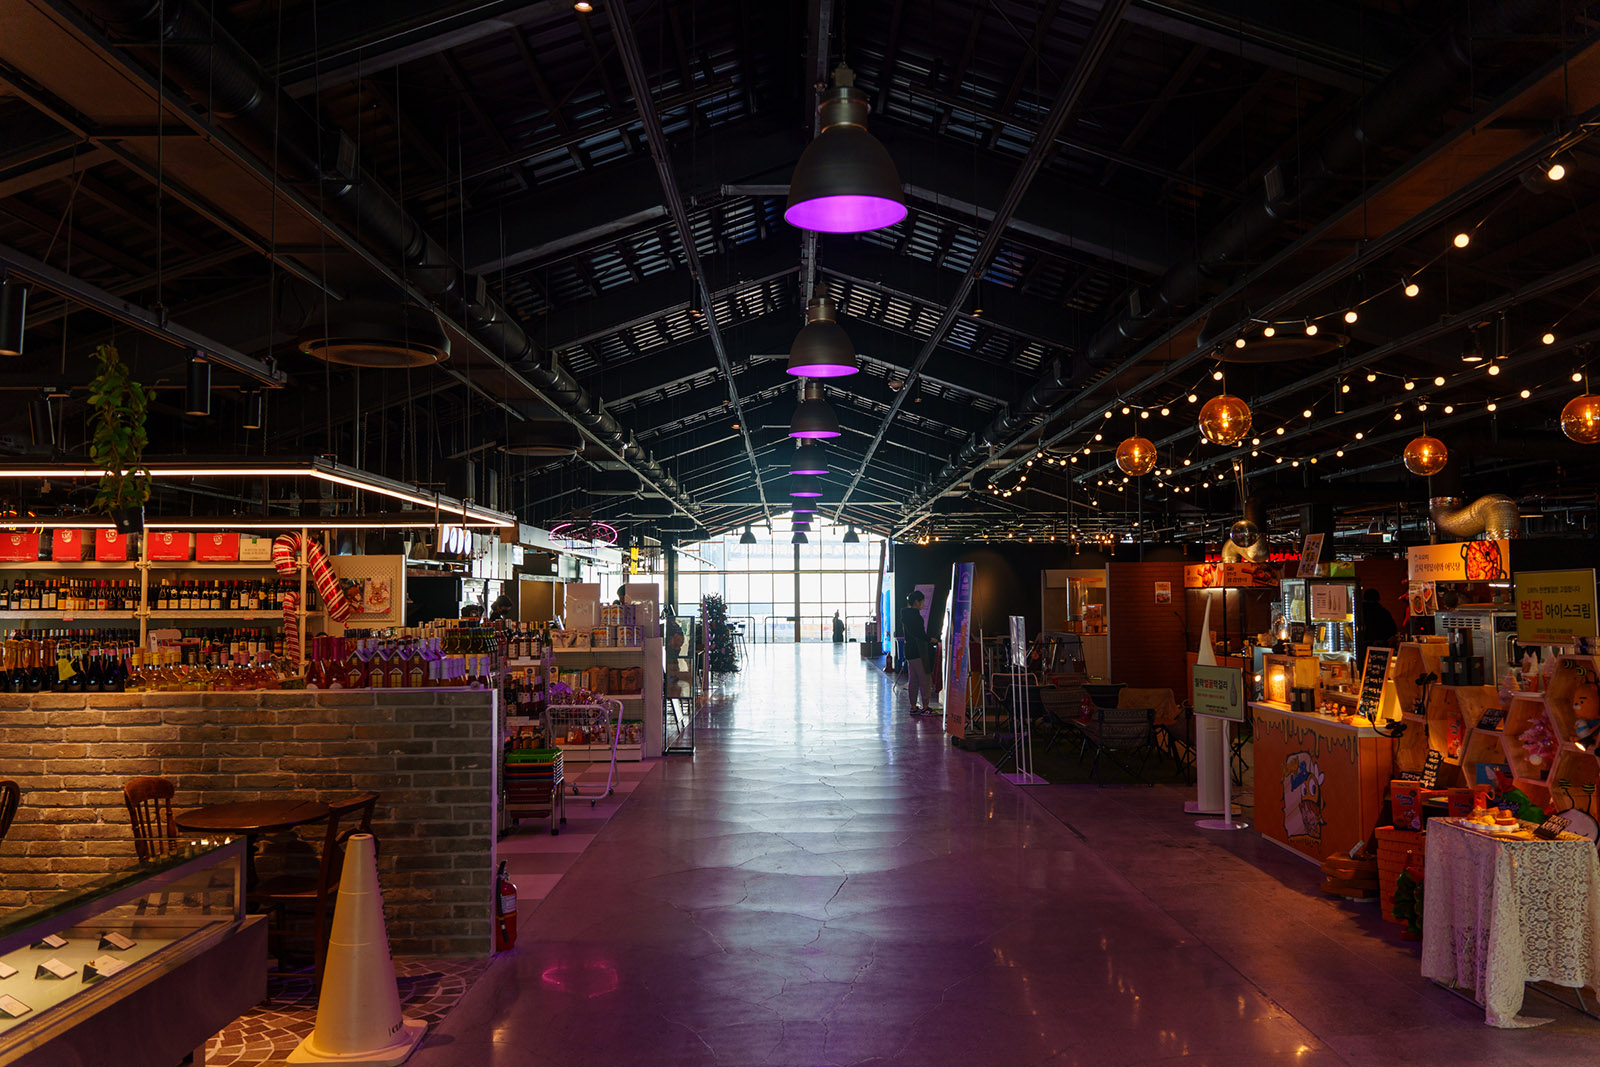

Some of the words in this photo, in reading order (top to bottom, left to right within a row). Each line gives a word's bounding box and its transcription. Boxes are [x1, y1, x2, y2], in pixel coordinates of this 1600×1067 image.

[440, 525, 472, 555] PODO
[1520, 600, 1544, 620] 벌집
[1545, 602, 1591, 620] 아이스크림
